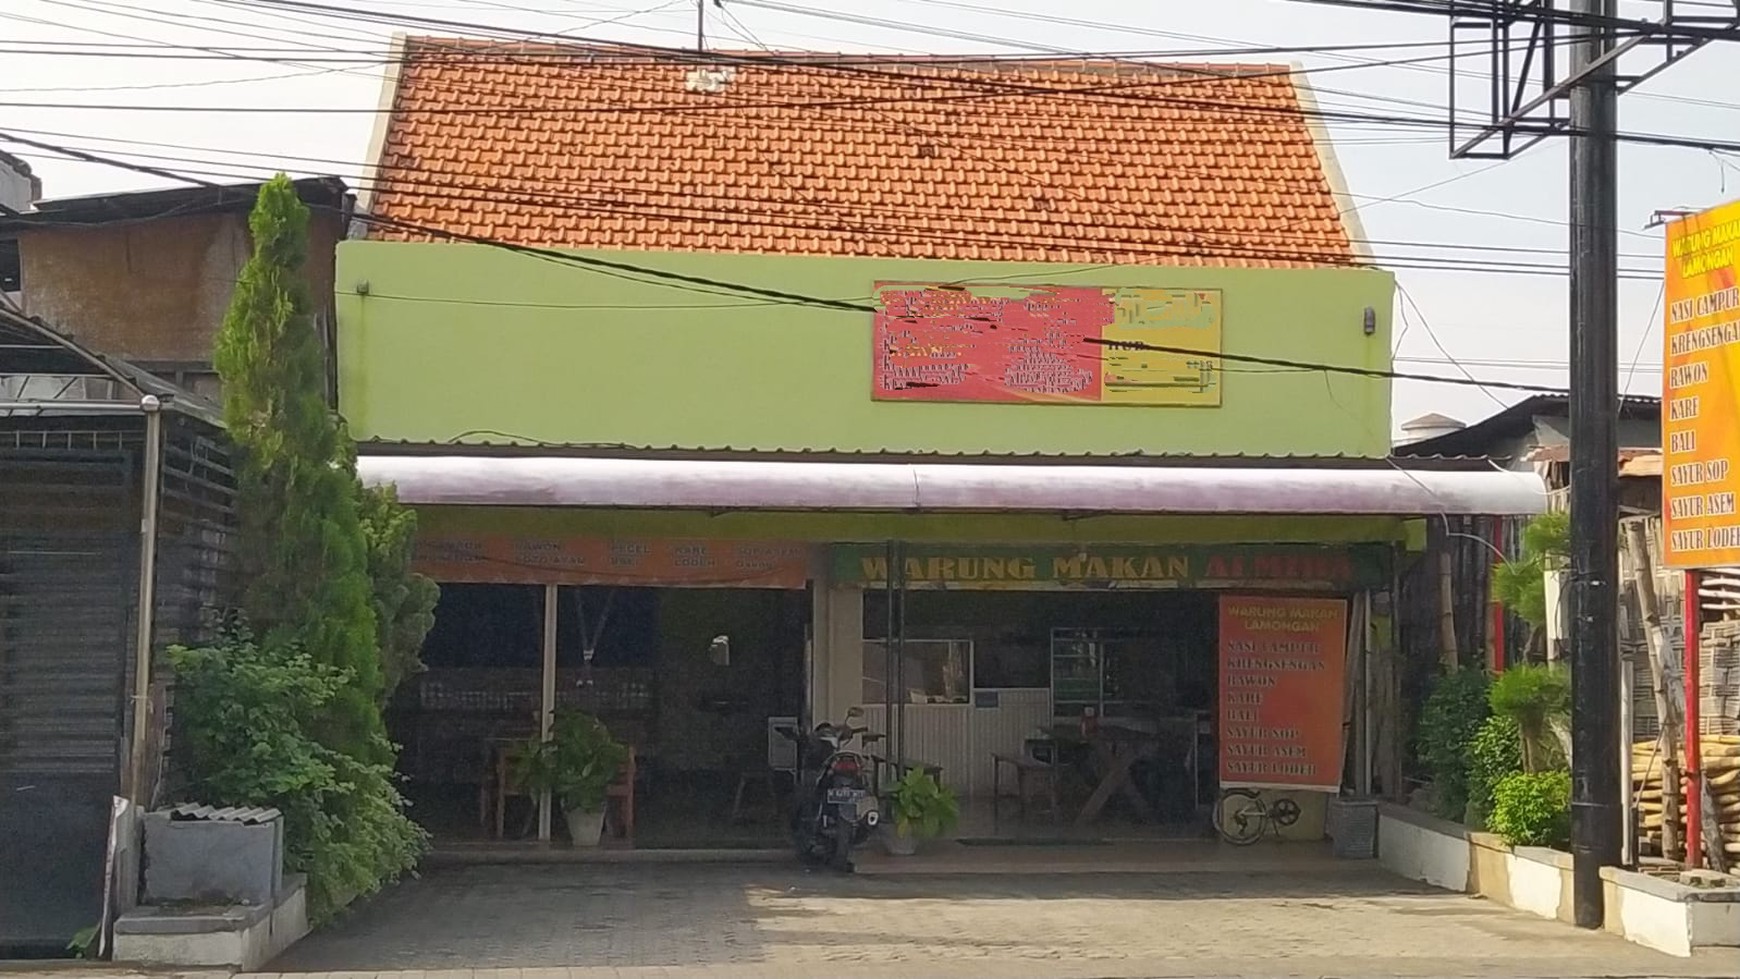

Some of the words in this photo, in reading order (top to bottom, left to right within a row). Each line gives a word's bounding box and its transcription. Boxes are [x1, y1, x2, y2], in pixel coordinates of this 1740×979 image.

[1712, 219, 1740, 247] MAKA
[1682, 245, 1734, 278] LAMONGAN
[1671, 299, 1693, 322] NASI
[1696, 287, 1740, 316] CAMPUR
[1671, 361, 1709, 388] RAWON
[1671, 397, 1699, 420] KARE
[1671, 430, 1696, 453] BALI
[1671, 464, 1704, 486] SAYUR
[1706, 460, 1729, 481] SOP
[1671, 496, 1704, 518] SAYUR
[1707, 493, 1735, 515] ASEM
[1671, 530, 1704, 550] SAYUR
[861, 556, 1037, 580] WARUNG
[1053, 555, 1189, 579] MAKAN
[1227, 605, 1287, 618] WARUNG
[1289, 606, 1338, 619] MAKAN
[1245, 619, 1320, 633] LAMONGAN
